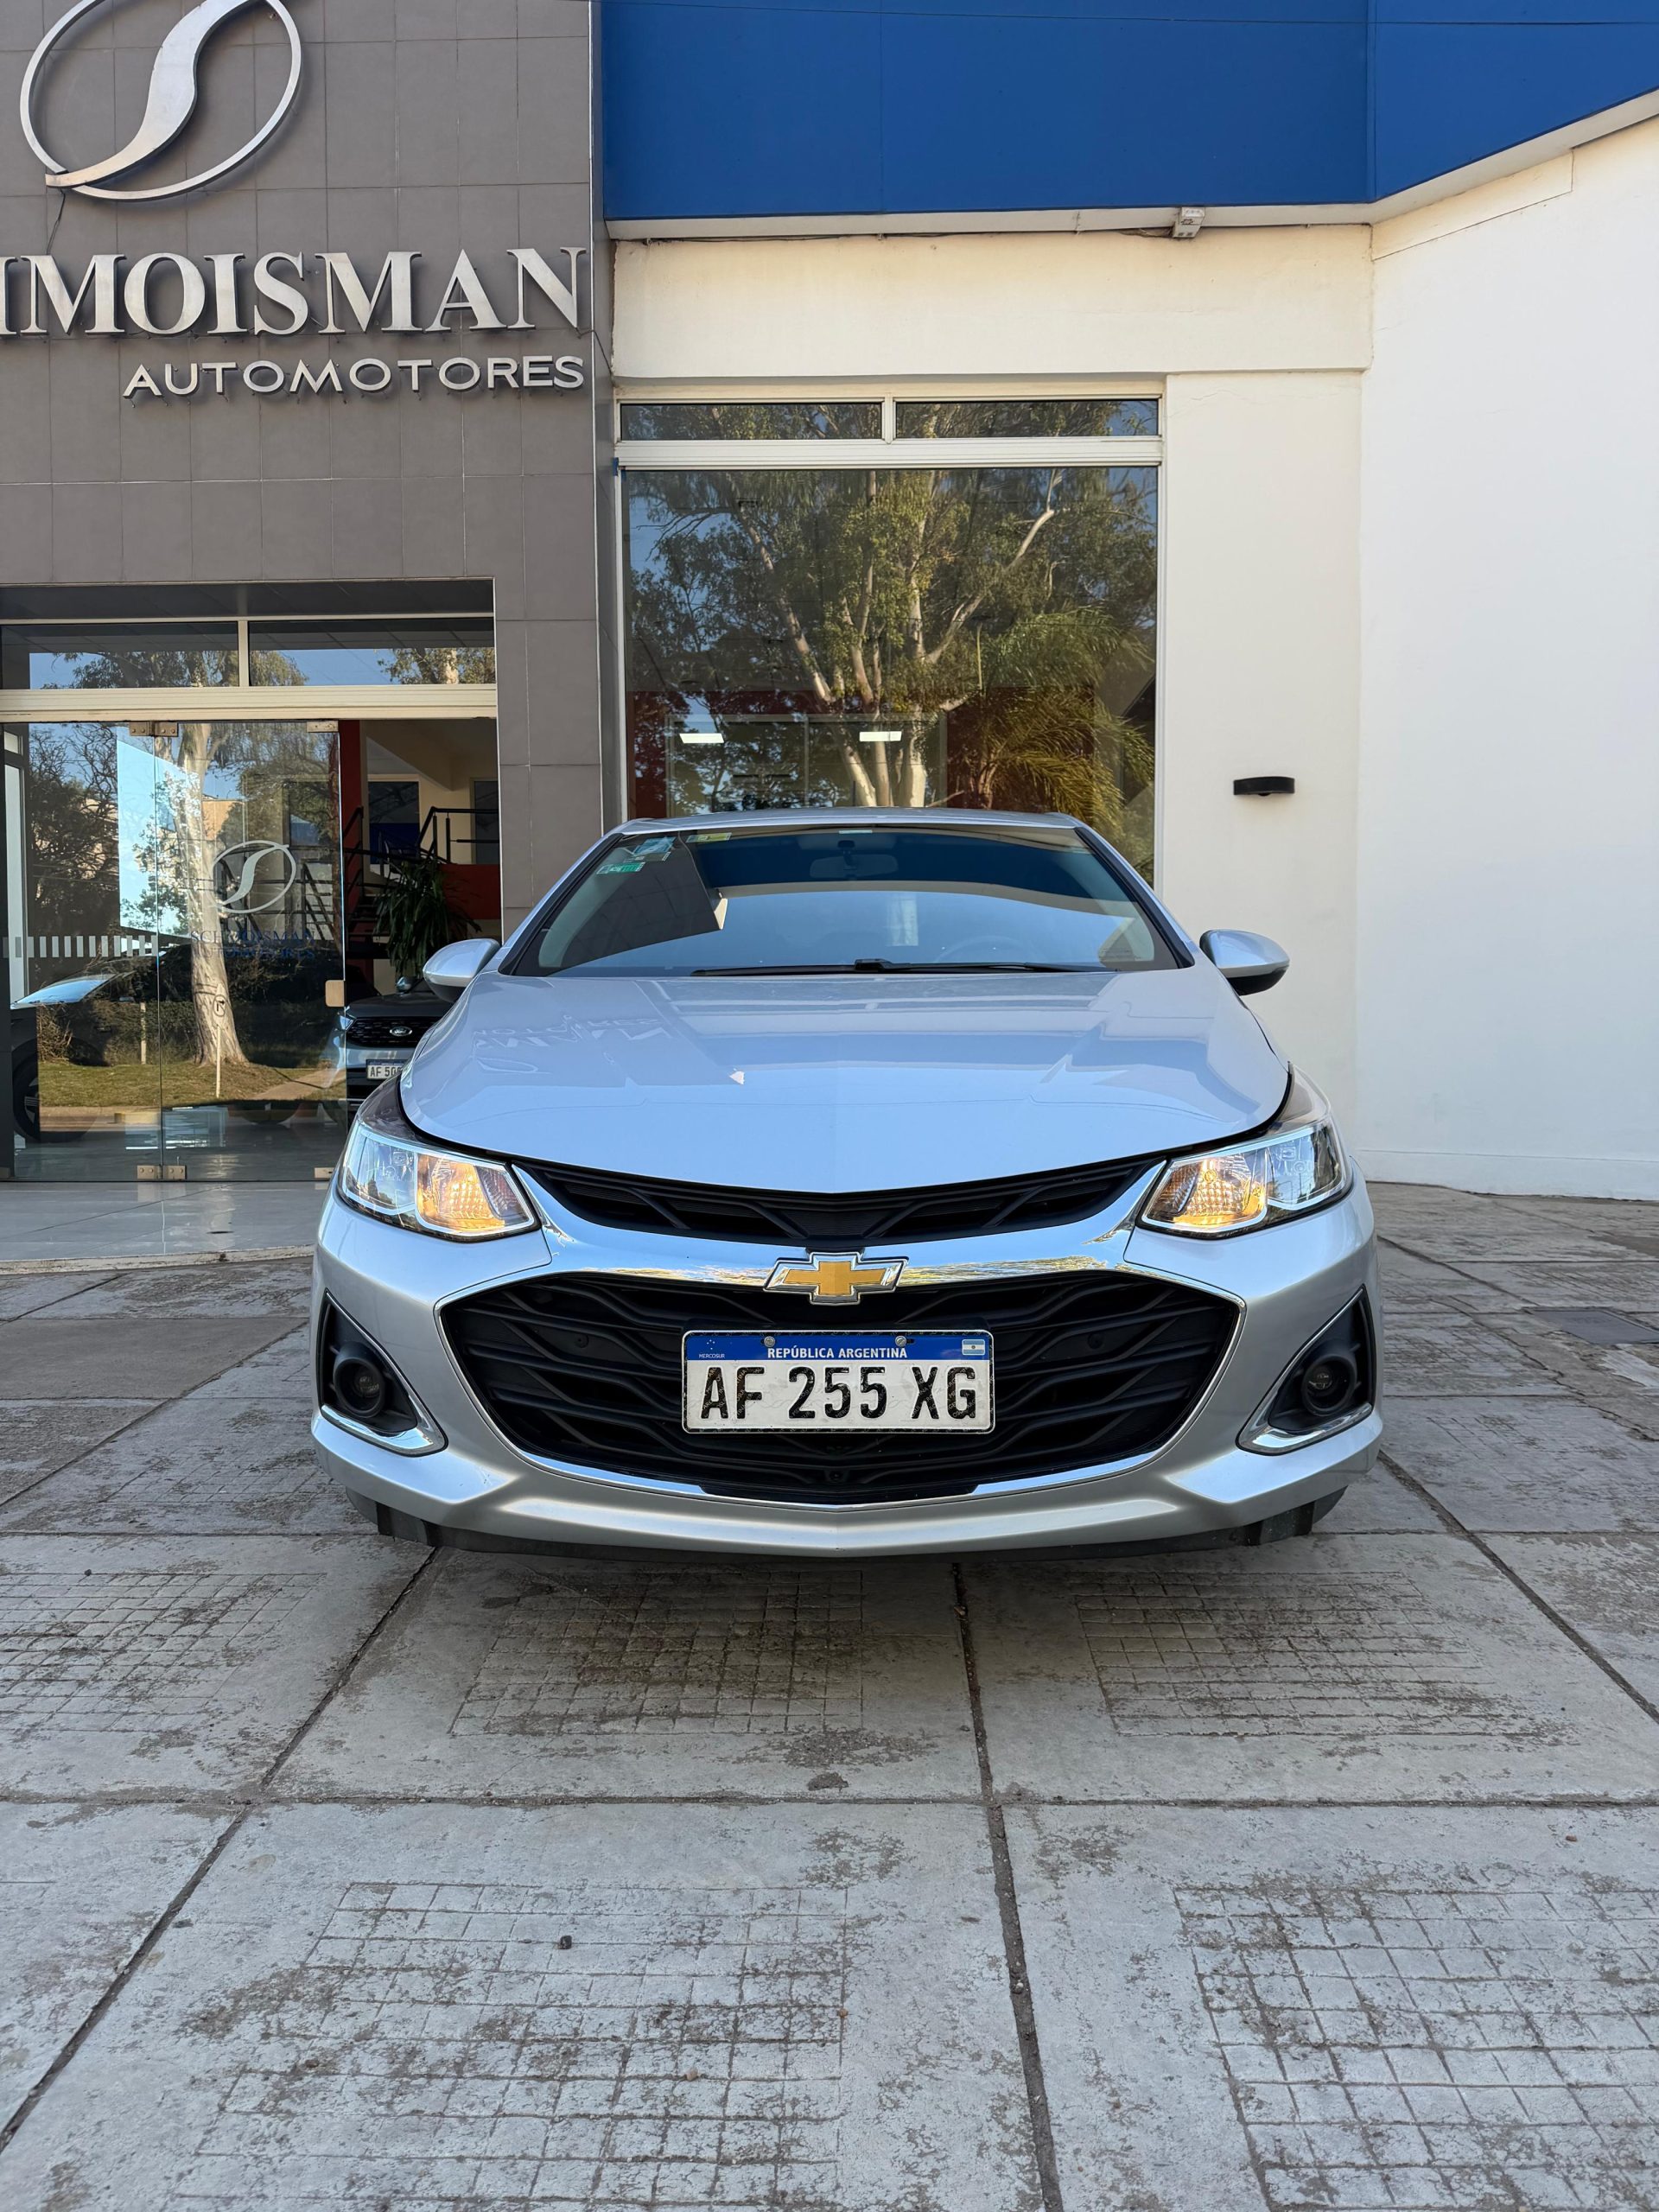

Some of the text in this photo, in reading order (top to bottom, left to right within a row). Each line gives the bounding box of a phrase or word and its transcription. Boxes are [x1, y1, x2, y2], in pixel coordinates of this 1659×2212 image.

[123, 355, 585, 397] AUTOMOTORES
[370, 1066, 401, 1077] AF 50
[767, 1344, 907, 1359] REPÚBLICA ARGENTINA
[701, 1366, 976, 1420] AF 255 XG
